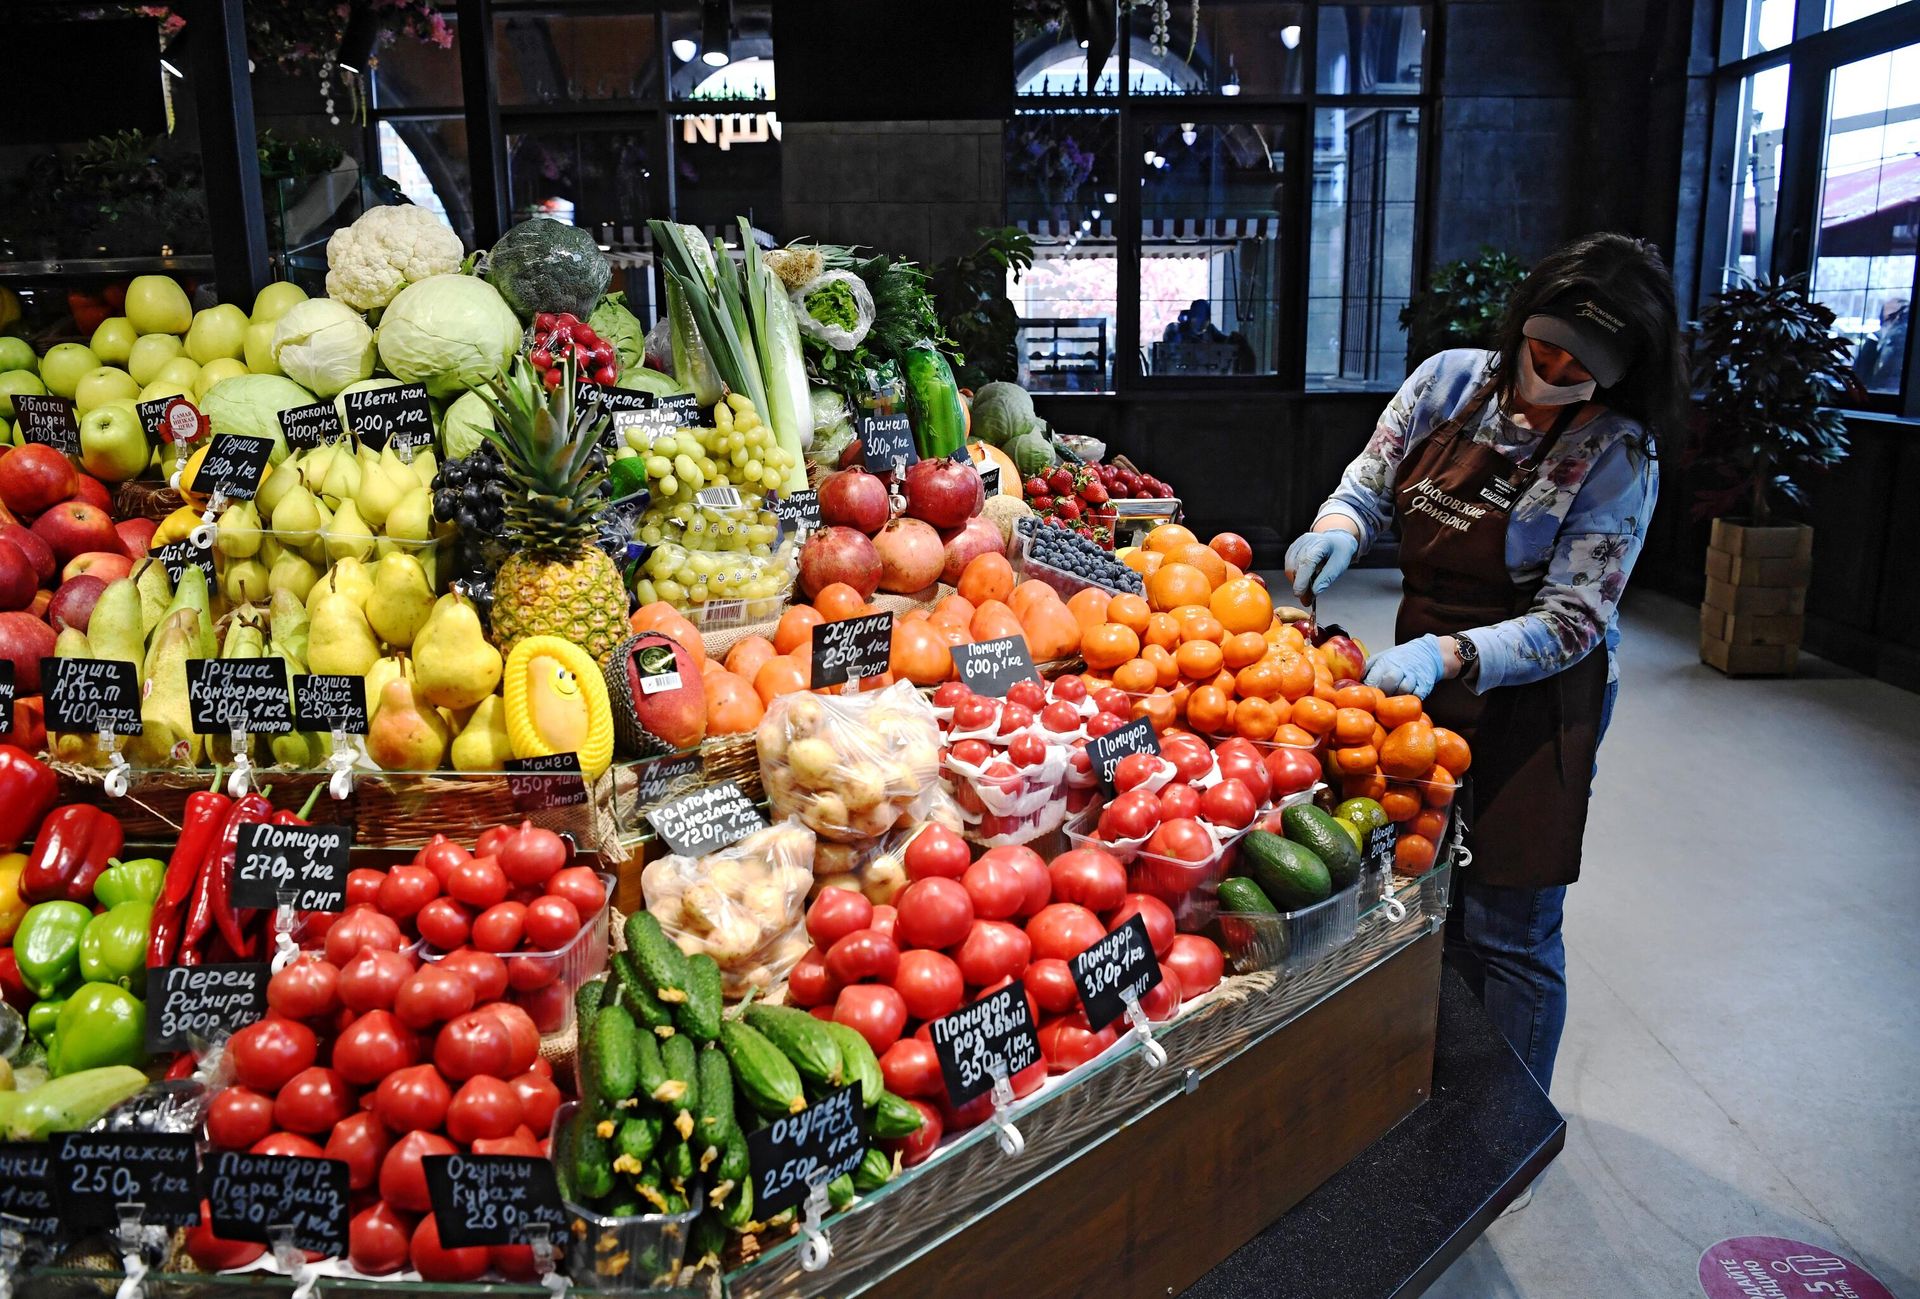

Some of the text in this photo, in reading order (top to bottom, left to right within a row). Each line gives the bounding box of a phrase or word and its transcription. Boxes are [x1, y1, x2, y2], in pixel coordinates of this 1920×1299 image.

[20, 396, 64, 414] Яблоки
[351, 388, 427, 412] Цветн. кап.
[29, 413, 66, 432] Голден
[283, 404, 335, 425] Брокколи
[397, 409, 428, 426] 1кг
[59, 429, 77, 443] 1кг
[287, 419, 338, 442] 400р 1кг
[864, 417, 910, 438] Гранат
[217, 434, 259, 456] Груша
[867, 436, 911, 457] 300р 1кг
[201, 456, 257, 481] 280р 1кг
[1403, 477, 1487, 519] Московские
[1404, 495, 1472, 532] Ярмарки
[823, 616, 891, 649] Хурма
[822, 639, 889, 669] 250р 1кг
[968, 640, 1012, 659] Помидор
[57, 657, 120, 687] Груша
[202, 659, 274, 686] Груша
[861, 661, 887, 678] СНГ
[966, 655, 1023, 679] 600р 1кг
[190, 680, 288, 706] Конференц
[308, 675, 351, 692] Груша
[252, 703, 287, 718] 1кг
[340, 704, 363, 718] 1кг
[1097, 725, 1148, 758] Помидор
[522, 756, 573, 771] Манго
[643, 761, 696, 781] Манго
[512, 777, 552, 798] 250р
[651, 784, 741, 826] Картофель
[664, 798, 754, 838] Синеглазка
[679, 811, 761, 848] 120р 1кг
[252, 824, 340, 859] Помидор
[240, 854, 334, 888] 270р 1кг
[302, 890, 342, 910] СНГ
[1078, 926, 1133, 974] Помидор
[167, 967, 256, 996] Перец
[1085, 946, 1145, 998] 380р 1кг
[1134, 973, 1150, 996] НГ
[164, 990, 254, 1014] Рамиро
[161, 1012, 220, 1038] 300р
[935, 992, 1010, 1044] Помидор
[1004, 1033, 1032, 1058] 1кг
[1010, 1048, 1035, 1072] СНГ
[771, 1088, 851, 1146] Огурец
[60, 1134, 189, 1162] Баклажан
[827, 1126, 858, 1158] 1кг
[219, 1152, 331, 1188] Помидор
[447, 1156, 532, 1188] Огурцы
[72, 1164, 190, 1203] 250р 1кг
[212, 1177, 346, 1220] Парадайз
[453, 1182, 527, 1211] Кураж
[293, 1211, 338, 1236] 1кг
[534, 1205, 565, 1224] 1кг
